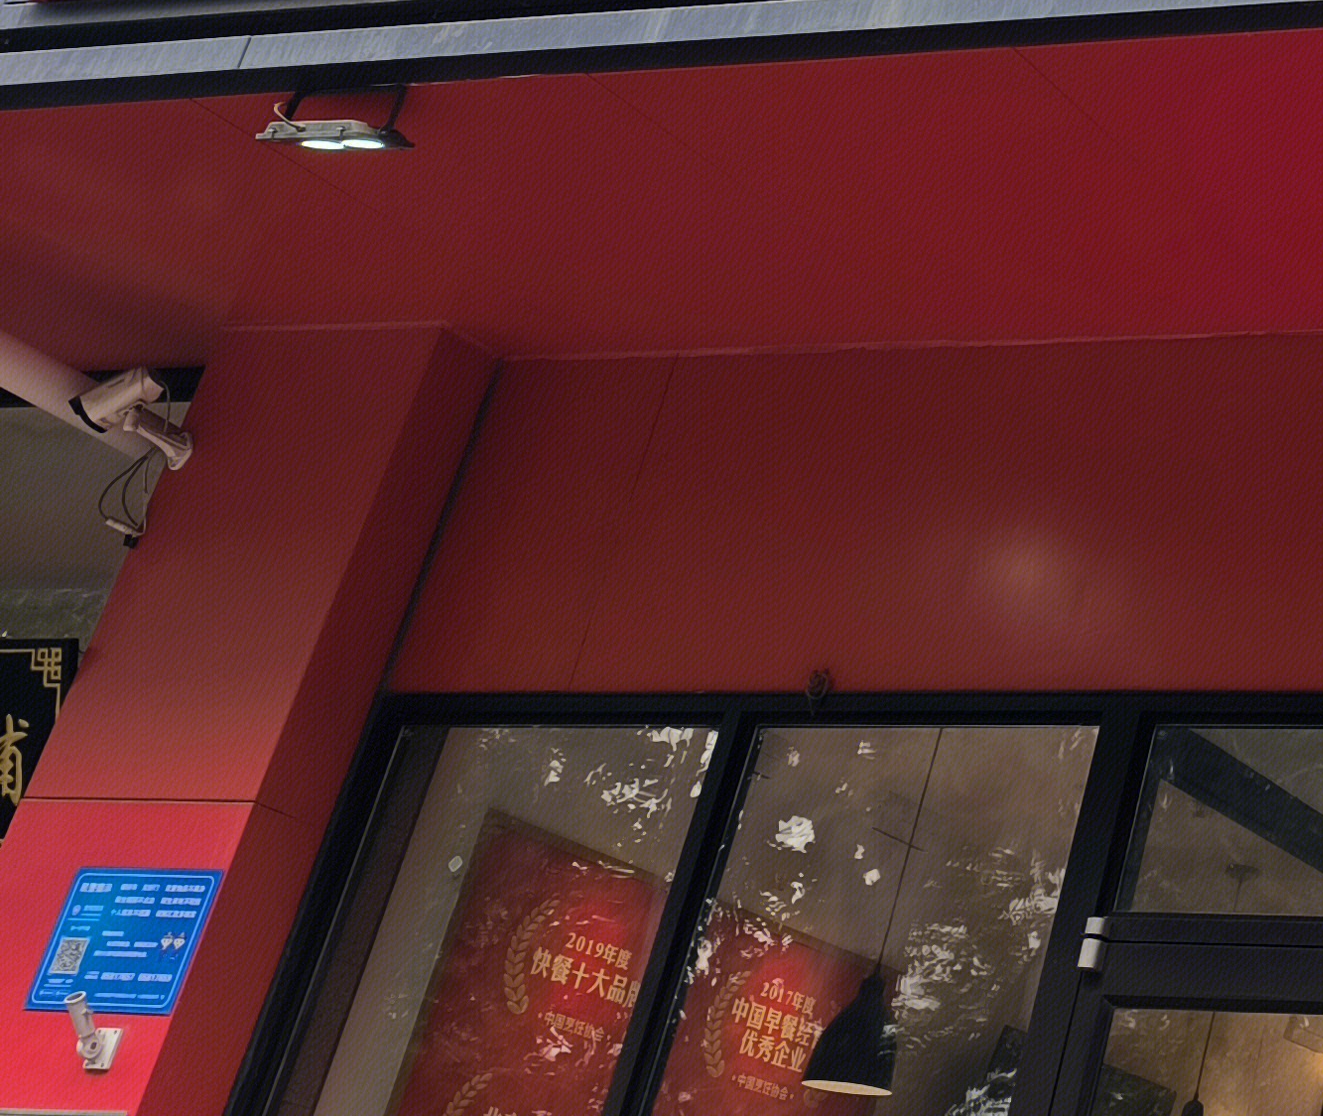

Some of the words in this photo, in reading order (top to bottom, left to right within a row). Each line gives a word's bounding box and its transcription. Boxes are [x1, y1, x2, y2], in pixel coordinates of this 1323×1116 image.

[565, 932, 633, 971] 2019年度
[760, 981, 817, 1020] 2017年度
[739, 1028, 807, 1073] 优秀企业
